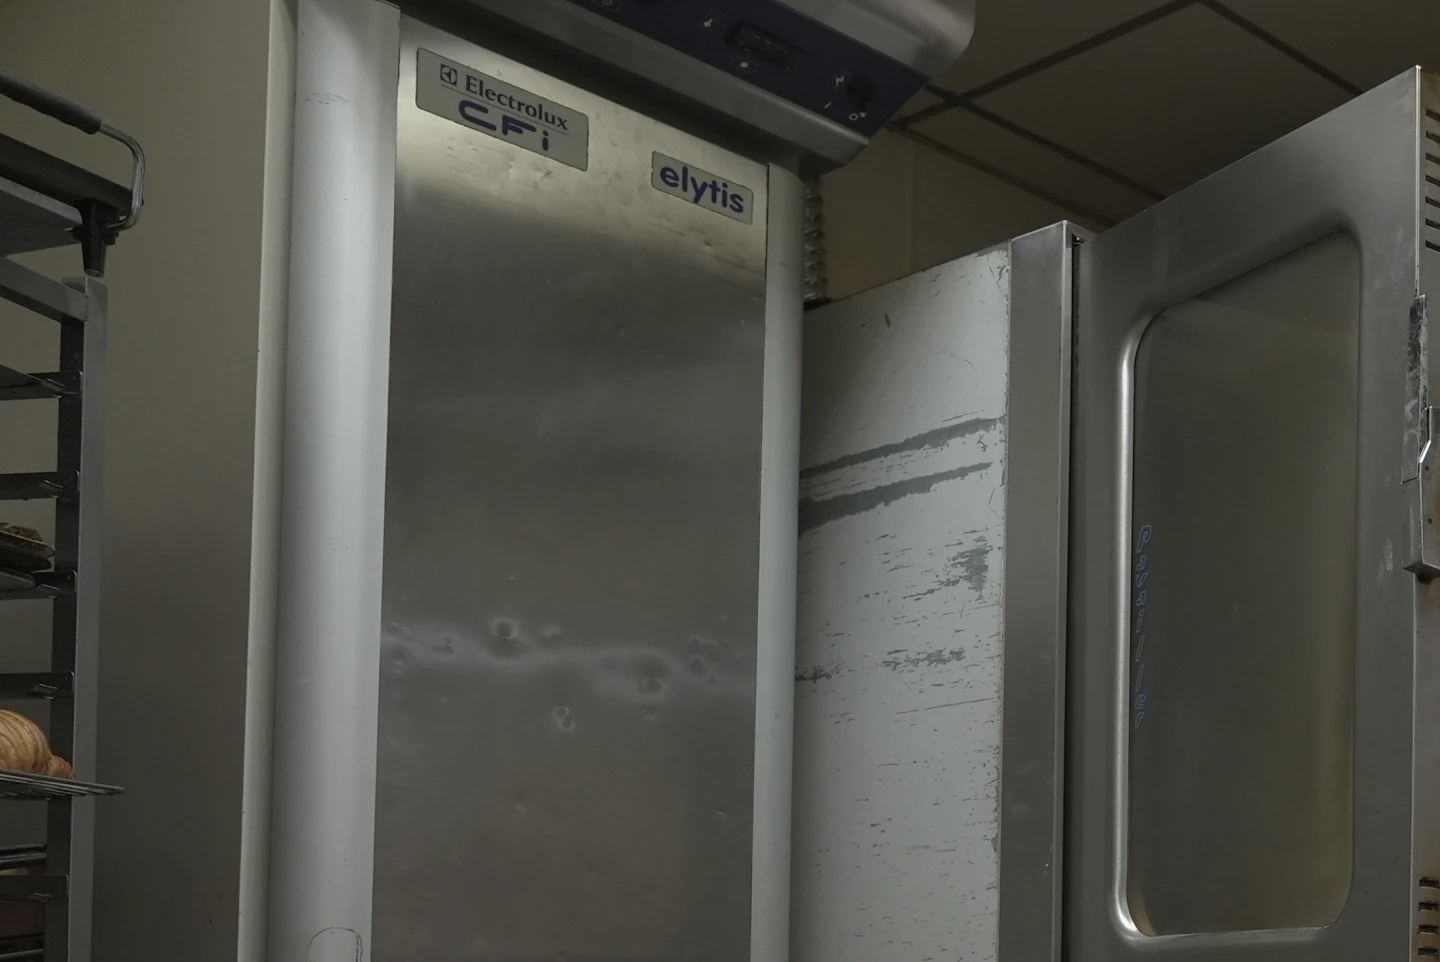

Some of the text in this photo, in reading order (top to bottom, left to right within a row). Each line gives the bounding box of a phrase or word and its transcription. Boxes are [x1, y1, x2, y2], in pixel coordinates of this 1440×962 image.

[459, 100, 549, 151] CFi
[466, 74, 568, 131] Electrolux
[660, 166, 744, 213] elytis
[1135, 524, 1152, 728] Pavailler
